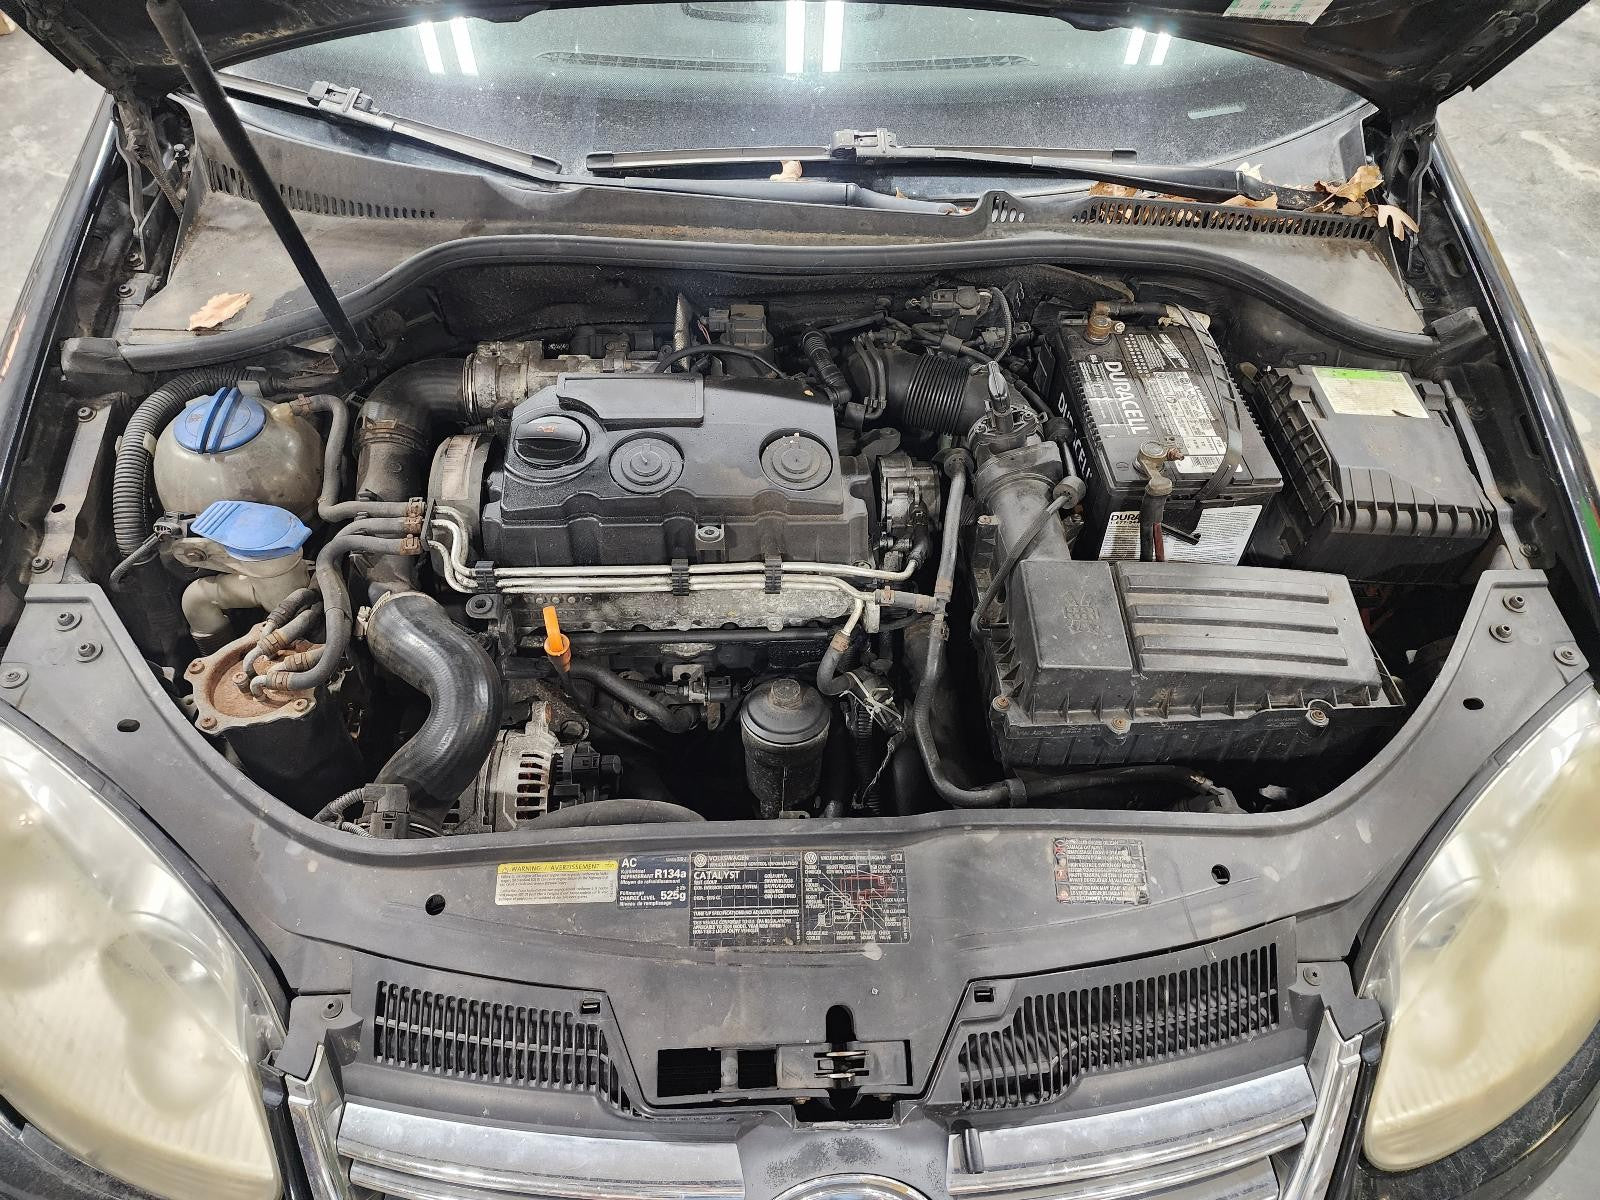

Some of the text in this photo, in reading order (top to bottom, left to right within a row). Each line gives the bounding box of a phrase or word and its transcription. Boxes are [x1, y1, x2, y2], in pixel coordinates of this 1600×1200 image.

[1103, 361, 1150, 435] DURACELL
[621, 858, 637, 868] AC
[654, 869, 687, 879] R134a
[693, 871, 740, 880] CATALYST
[661, 891, 686, 901] 525g
